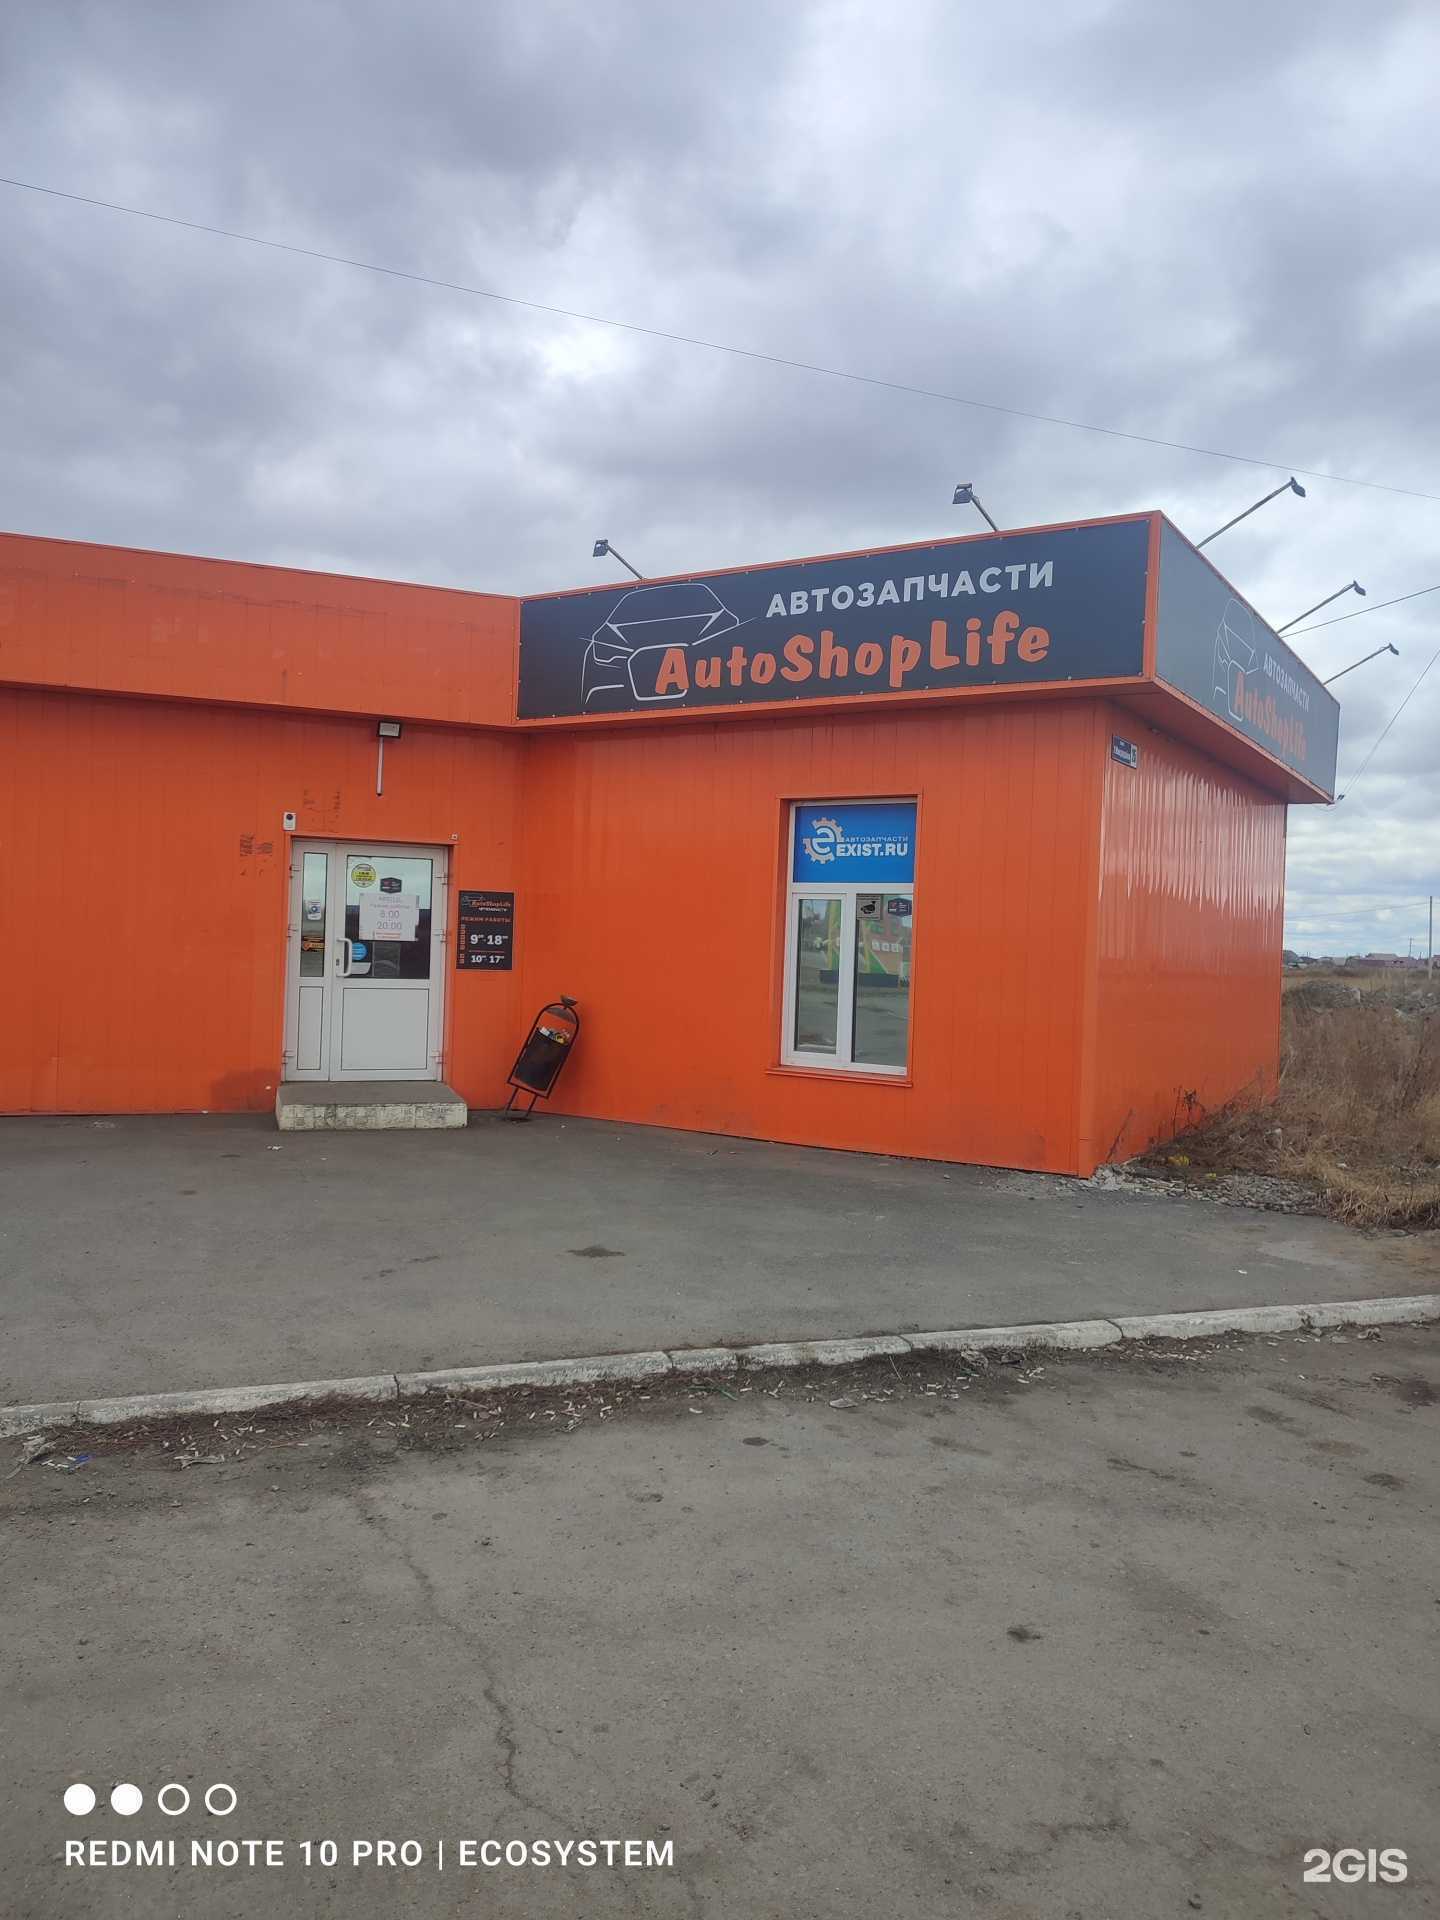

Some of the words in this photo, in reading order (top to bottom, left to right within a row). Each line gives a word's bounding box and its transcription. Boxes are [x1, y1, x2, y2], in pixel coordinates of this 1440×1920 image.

[766, 560, 1055, 618] АВТОЗАПЧАСТИ
[655, 610, 1050, 694] AutoShopLife
[836, 843, 908, 857] EXIST.RU
[845, 835, 908, 843] АВТОЗАПЧАСТИ
